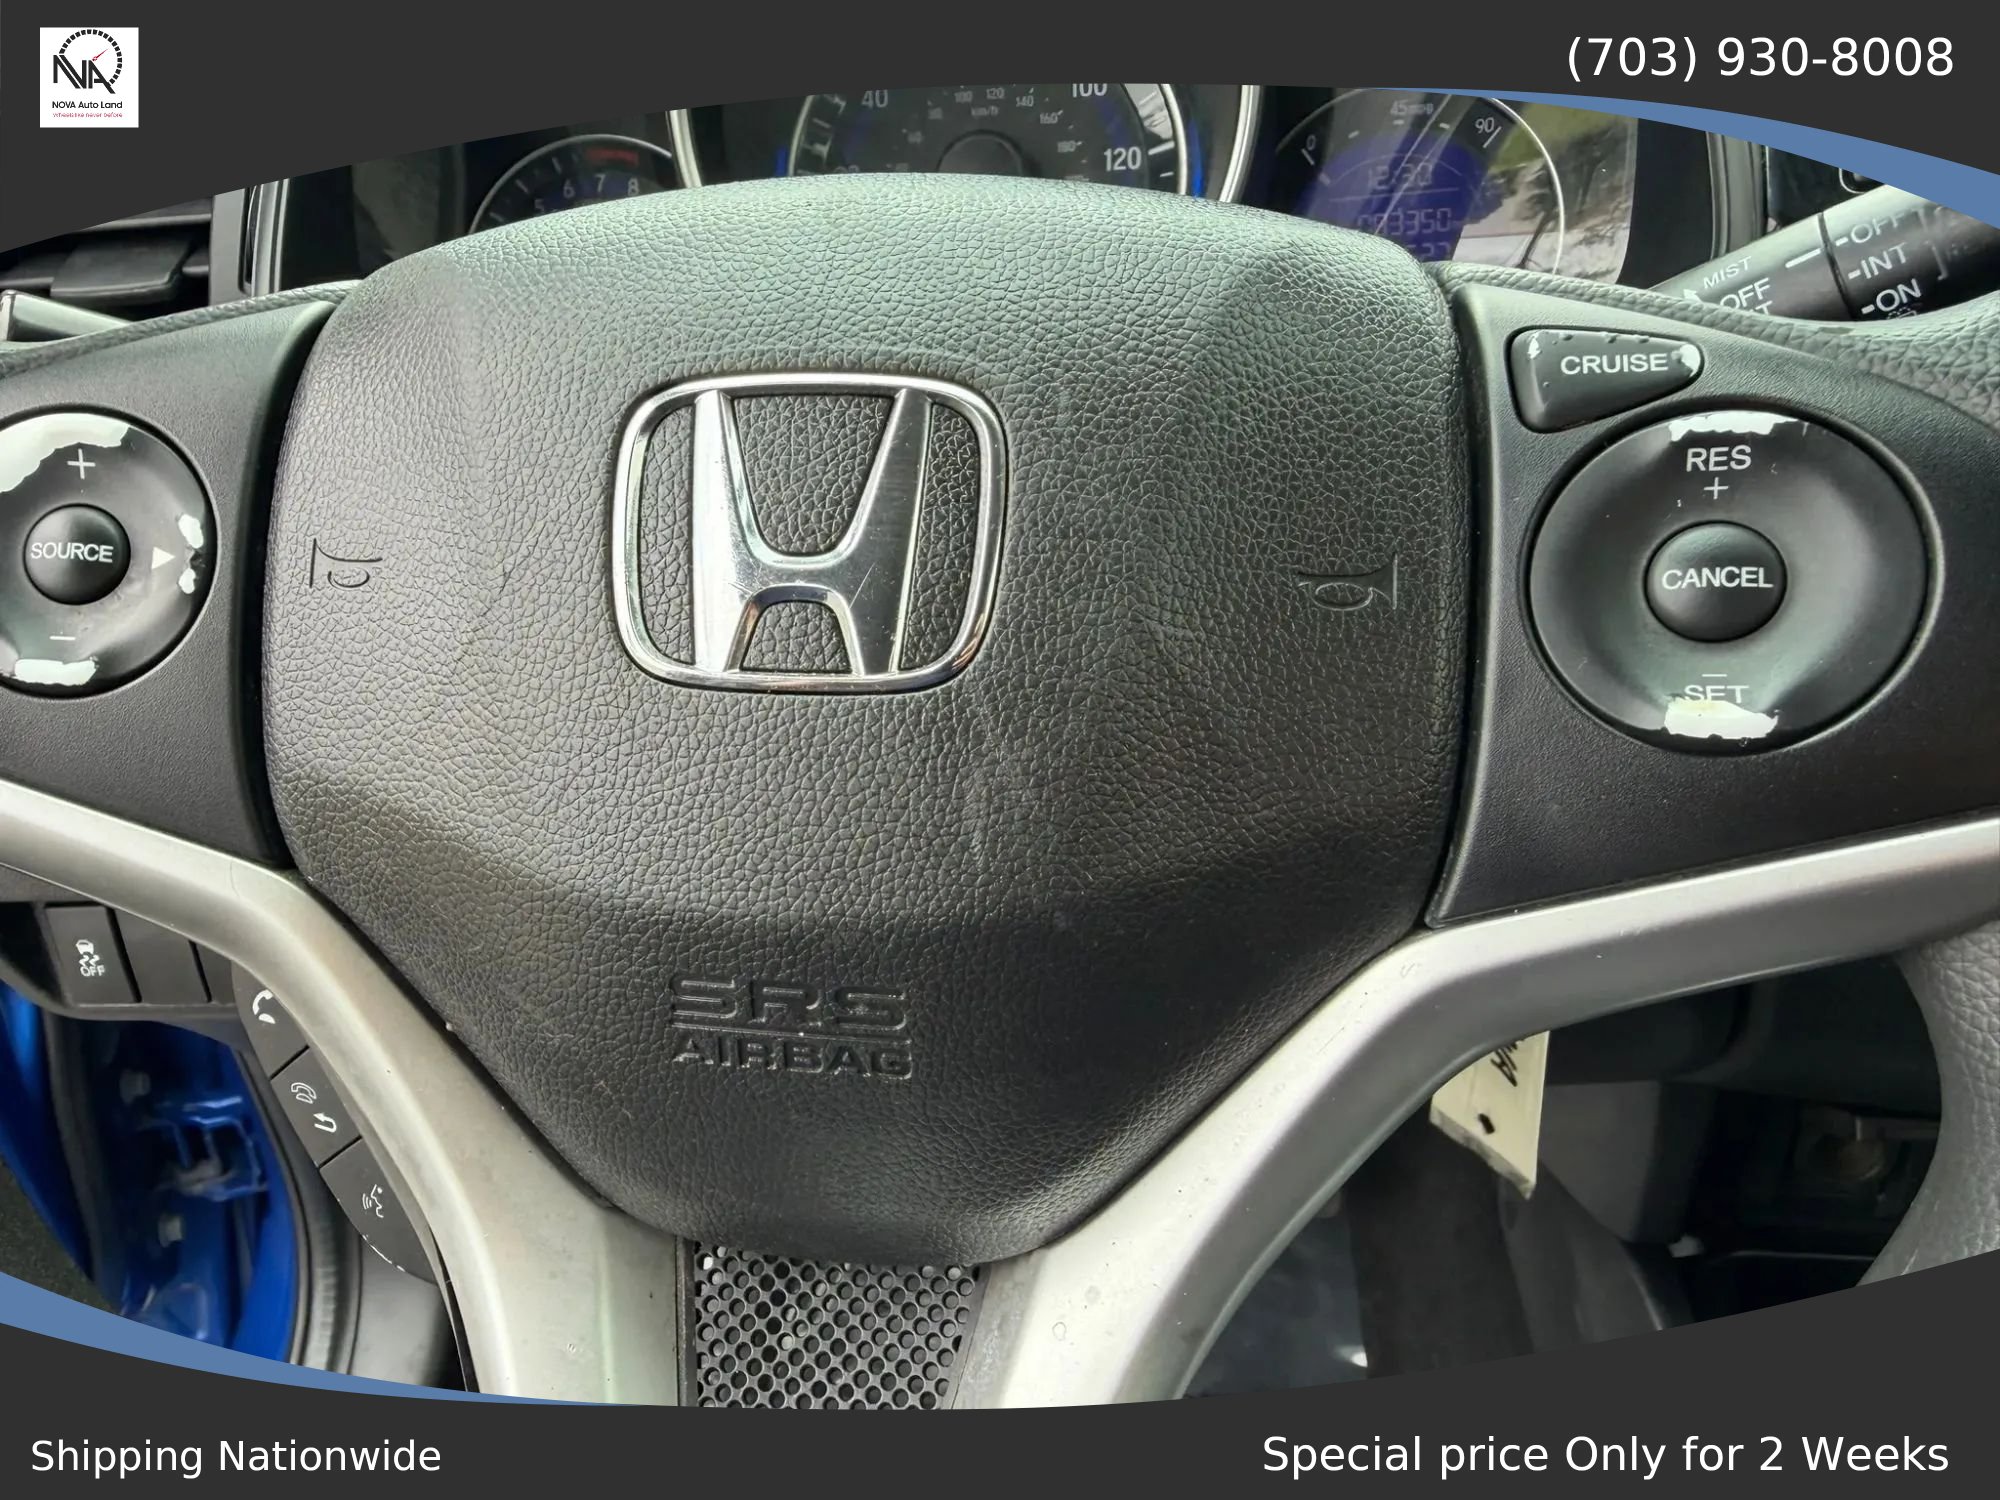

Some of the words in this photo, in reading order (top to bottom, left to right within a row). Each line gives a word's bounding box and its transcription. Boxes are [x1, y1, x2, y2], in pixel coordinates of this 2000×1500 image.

[1475, 117, 1495, 134] 90
[1306, 134, 1317, 150] 0
[1104, 147, 1142, 171] 120
[563, 180, 575, 198] 6
[594, 174, 606, 192] 7
[627, 178, 639, 197] 8
[1703, 256, 1752, 289] MIST
[1861, 242, 1906, 279] INT
[1720, 277, 1770, 309] OFF
[1876, 278, 1922, 312] ON
[1560, 353, 1668, 375] CRUISE
[1686, 445, 1751, 472] RES
[31, 542, 114, 563] SOURCE
[1662, 566, 1773, 590] CANCEL
[80, 965, 105, 977] OFF
[670, 978, 908, 1031] SRS
[672, 1036, 913, 1080] AIRBAG
